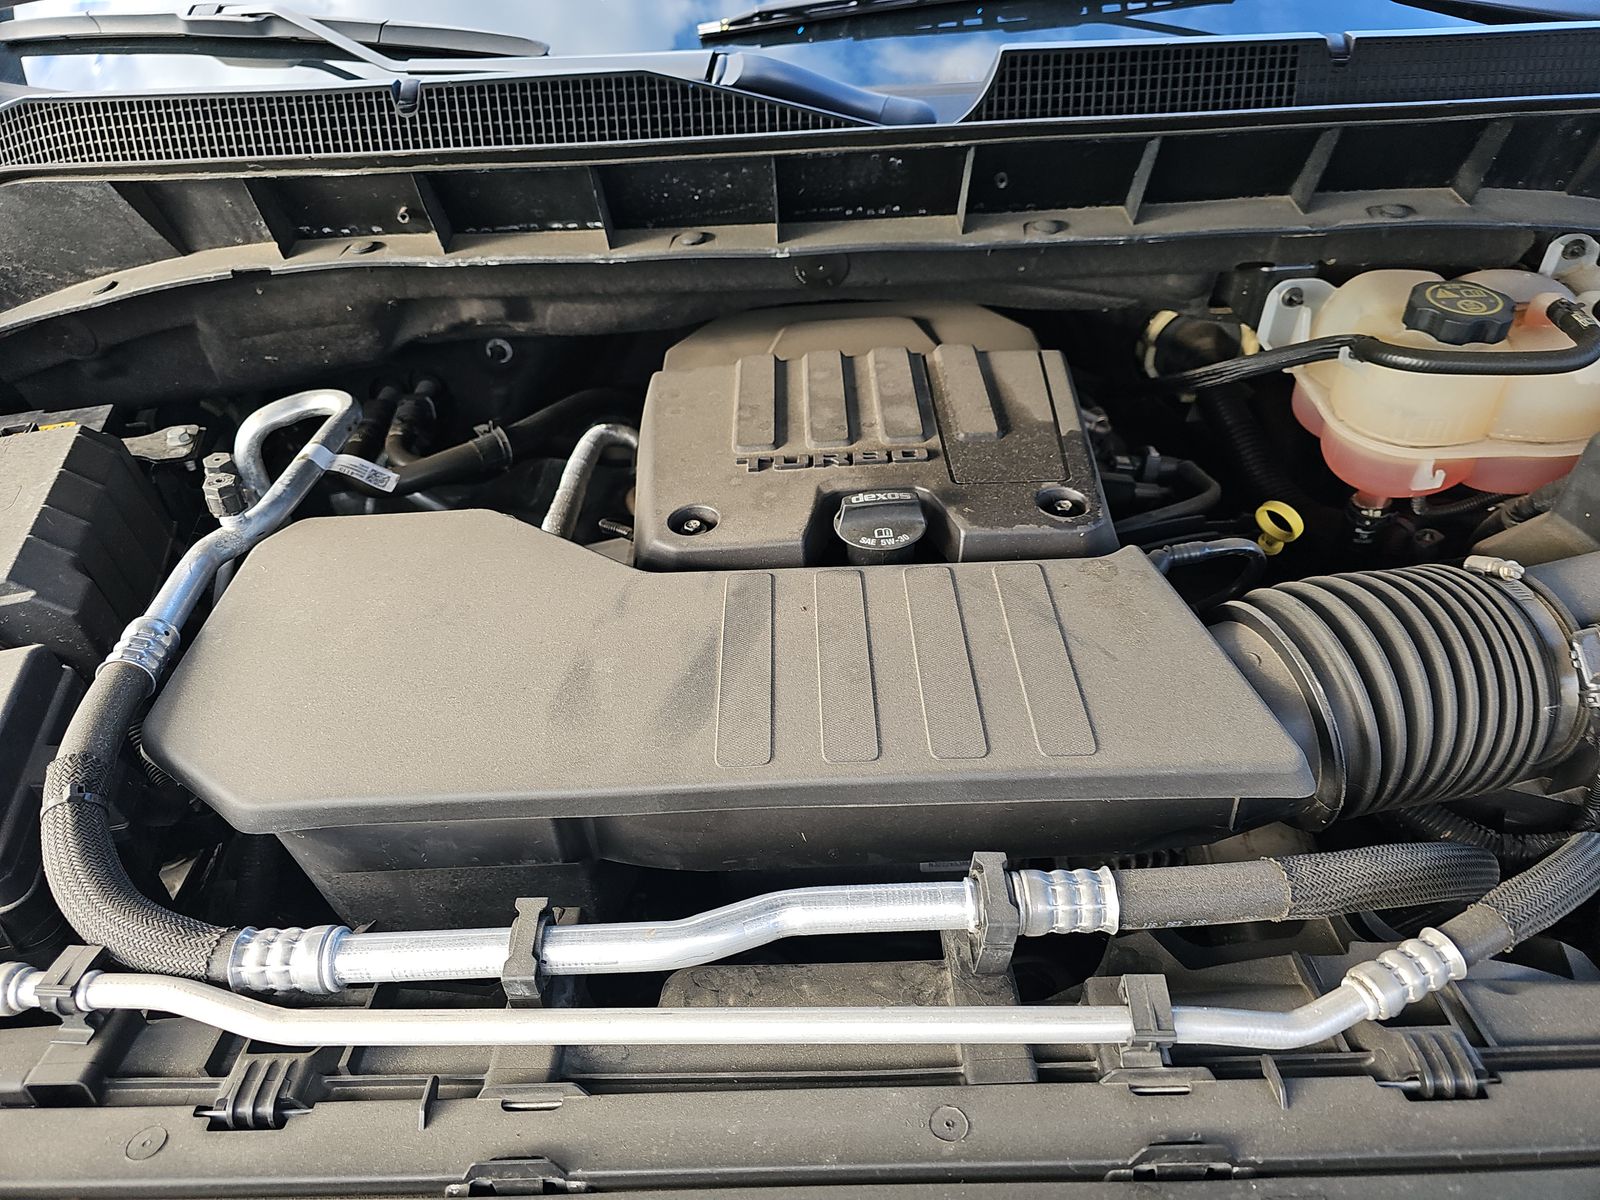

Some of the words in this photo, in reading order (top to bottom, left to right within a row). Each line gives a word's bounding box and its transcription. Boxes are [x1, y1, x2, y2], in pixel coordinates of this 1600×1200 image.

[736, 449, 930, 472] TURBO
[852, 492, 911, 504] dexos
[859, 536, 877, 546] SAE
[880, 533, 910, 546] 5W-30
